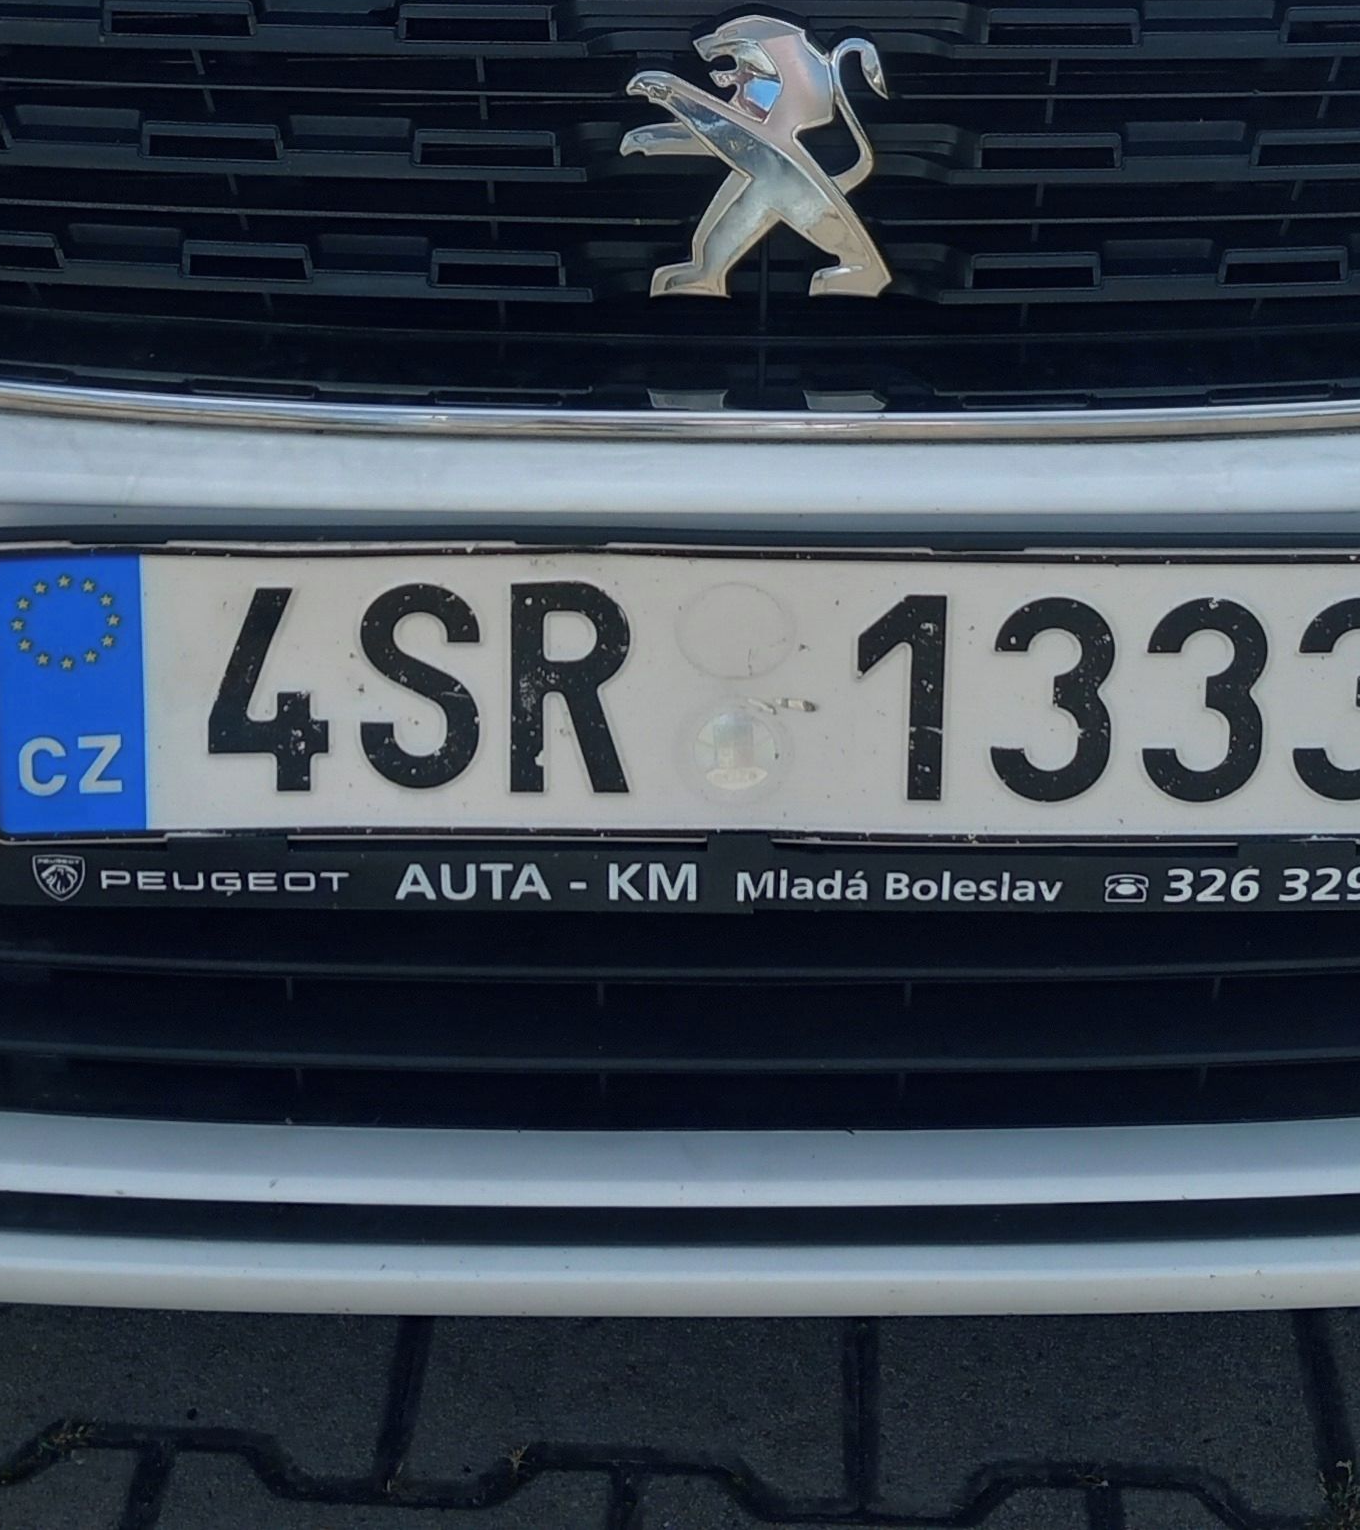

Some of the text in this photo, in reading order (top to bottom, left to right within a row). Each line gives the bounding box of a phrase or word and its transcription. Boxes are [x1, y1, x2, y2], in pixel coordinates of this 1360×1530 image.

[207, 580, 632, 794] 4SR
[17, 733, 125, 797] CZ
[100, 870, 350, 893] PEUGEOT
[395, 862, 551, 903] AUTA
[607, 861, 698, 903] KM
[736, 870, 869, 903] Mladá
[884, 870, 1063, 904] Boleslav
[1162, 868, 1261, 904] 326
